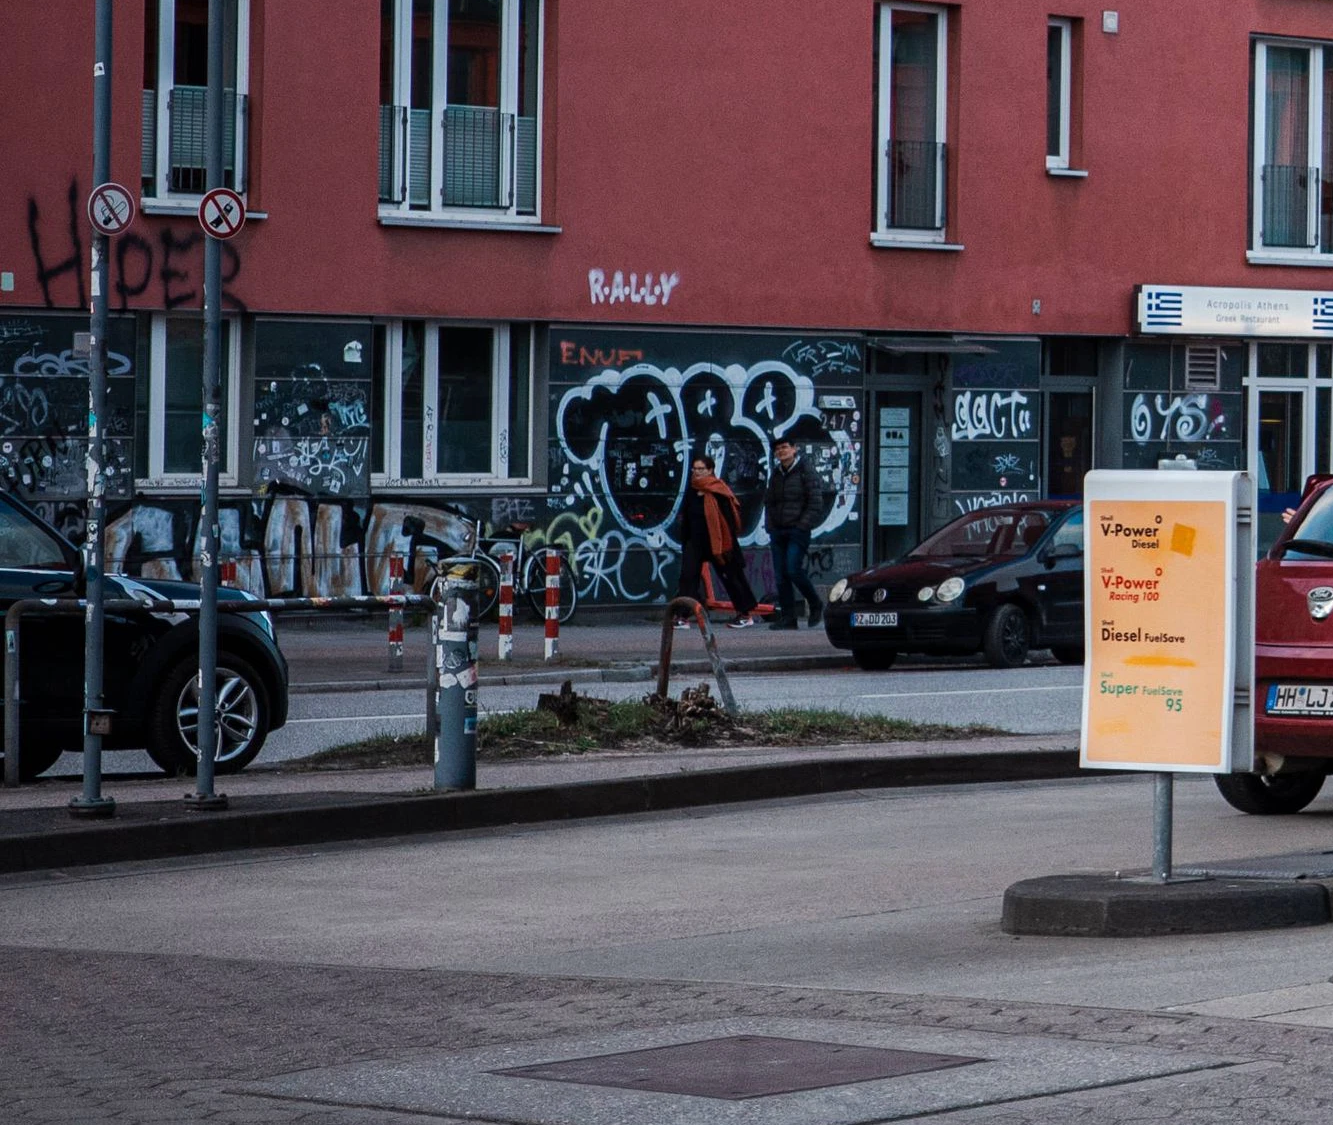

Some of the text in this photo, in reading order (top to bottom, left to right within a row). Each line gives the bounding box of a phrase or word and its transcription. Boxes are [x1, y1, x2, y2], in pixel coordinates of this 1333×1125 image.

[1207, 299, 1290, 312] Acropolis Athens
[1216, 314, 1280, 324] Greek Restaurant
[1101, 524, 1159, 538] V-Power
[1132, 539, 1159, 549] Diesel
[1101, 576, 1159, 590] V-Power
[1109, 591, 1160, 604] Racing 100
[1101, 627, 1185, 643] Diesel FuelSave
[1100, 680, 1184, 697] Super FuelSave
[1276, 687, 1298, 707] HH
[1306, 688, 1328, 708] LJ
[1166, 698, 1183, 712] 95
